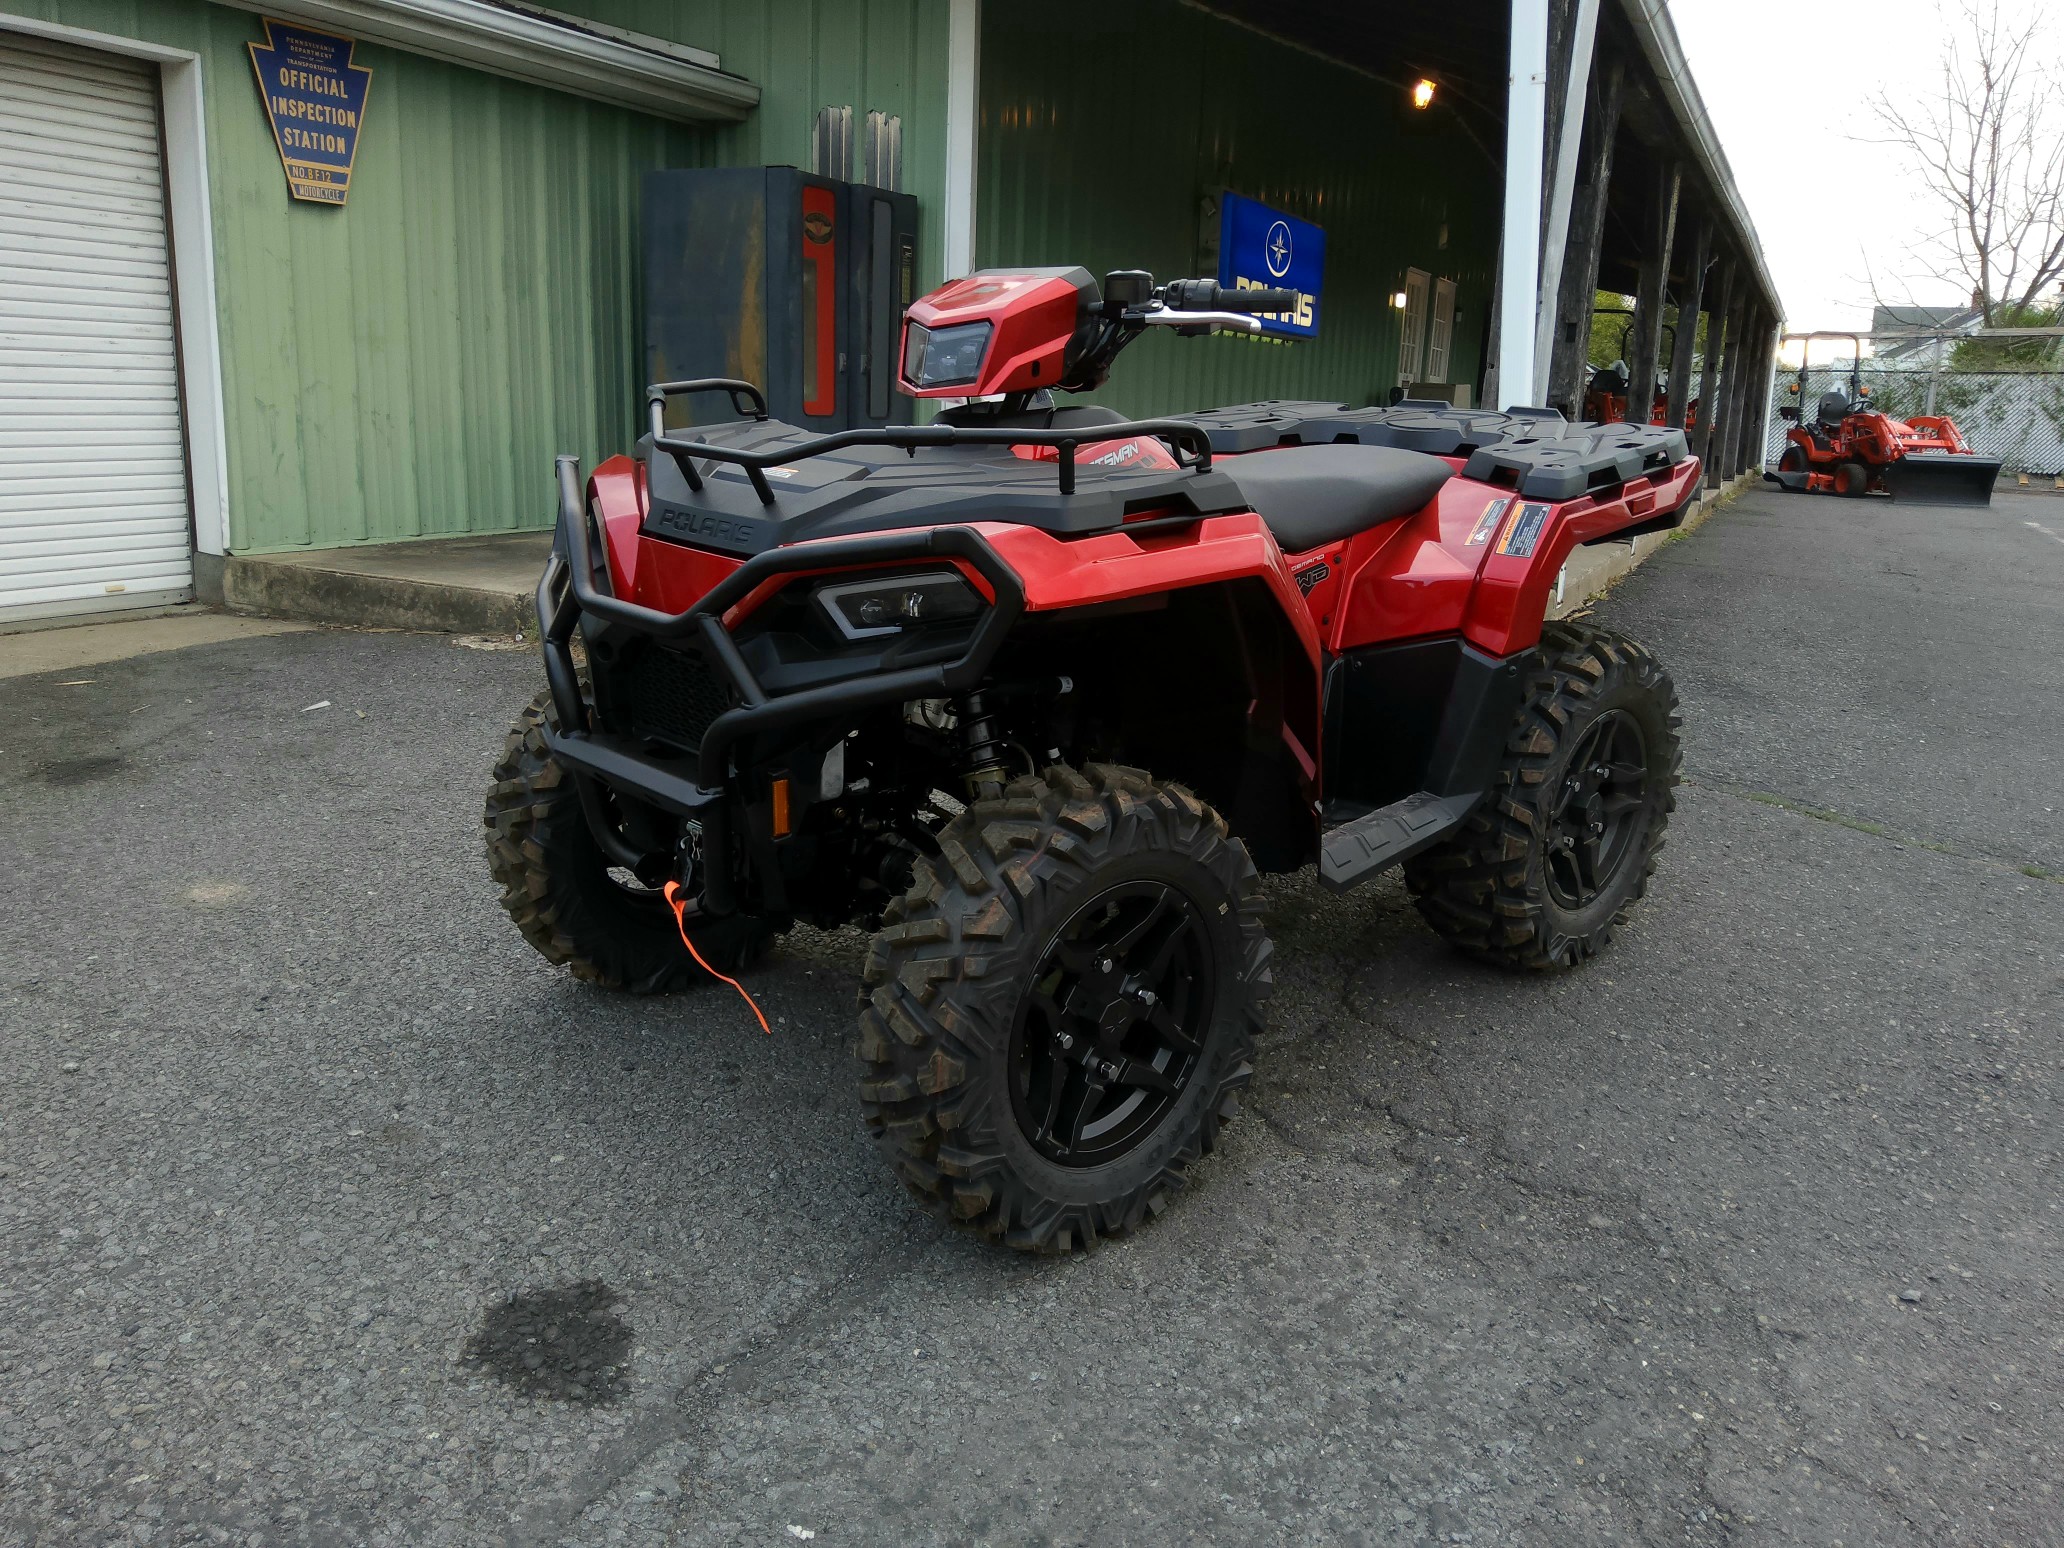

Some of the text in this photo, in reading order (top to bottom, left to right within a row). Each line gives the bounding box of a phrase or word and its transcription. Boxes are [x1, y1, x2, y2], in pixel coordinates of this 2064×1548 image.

[286, 36, 335, 53] PENNSYLVANIA
[290, 45, 332, 60] DEPARTMENT
[287, 58, 337, 74] TRANSPORTATION
[280, 67, 348, 99] OFFICIAL
[272, 96, 356, 128] INSPECTION
[284, 128, 346, 154] STATION
[299, 184, 340, 200] MOTORCYCLE
[1237, 276, 1314, 327] POIS
[1089, 440, 1139, 466] TSMAN
[659, 508, 754, 546] POLARIS
[1291, 553, 1325, 571] DEMAND
